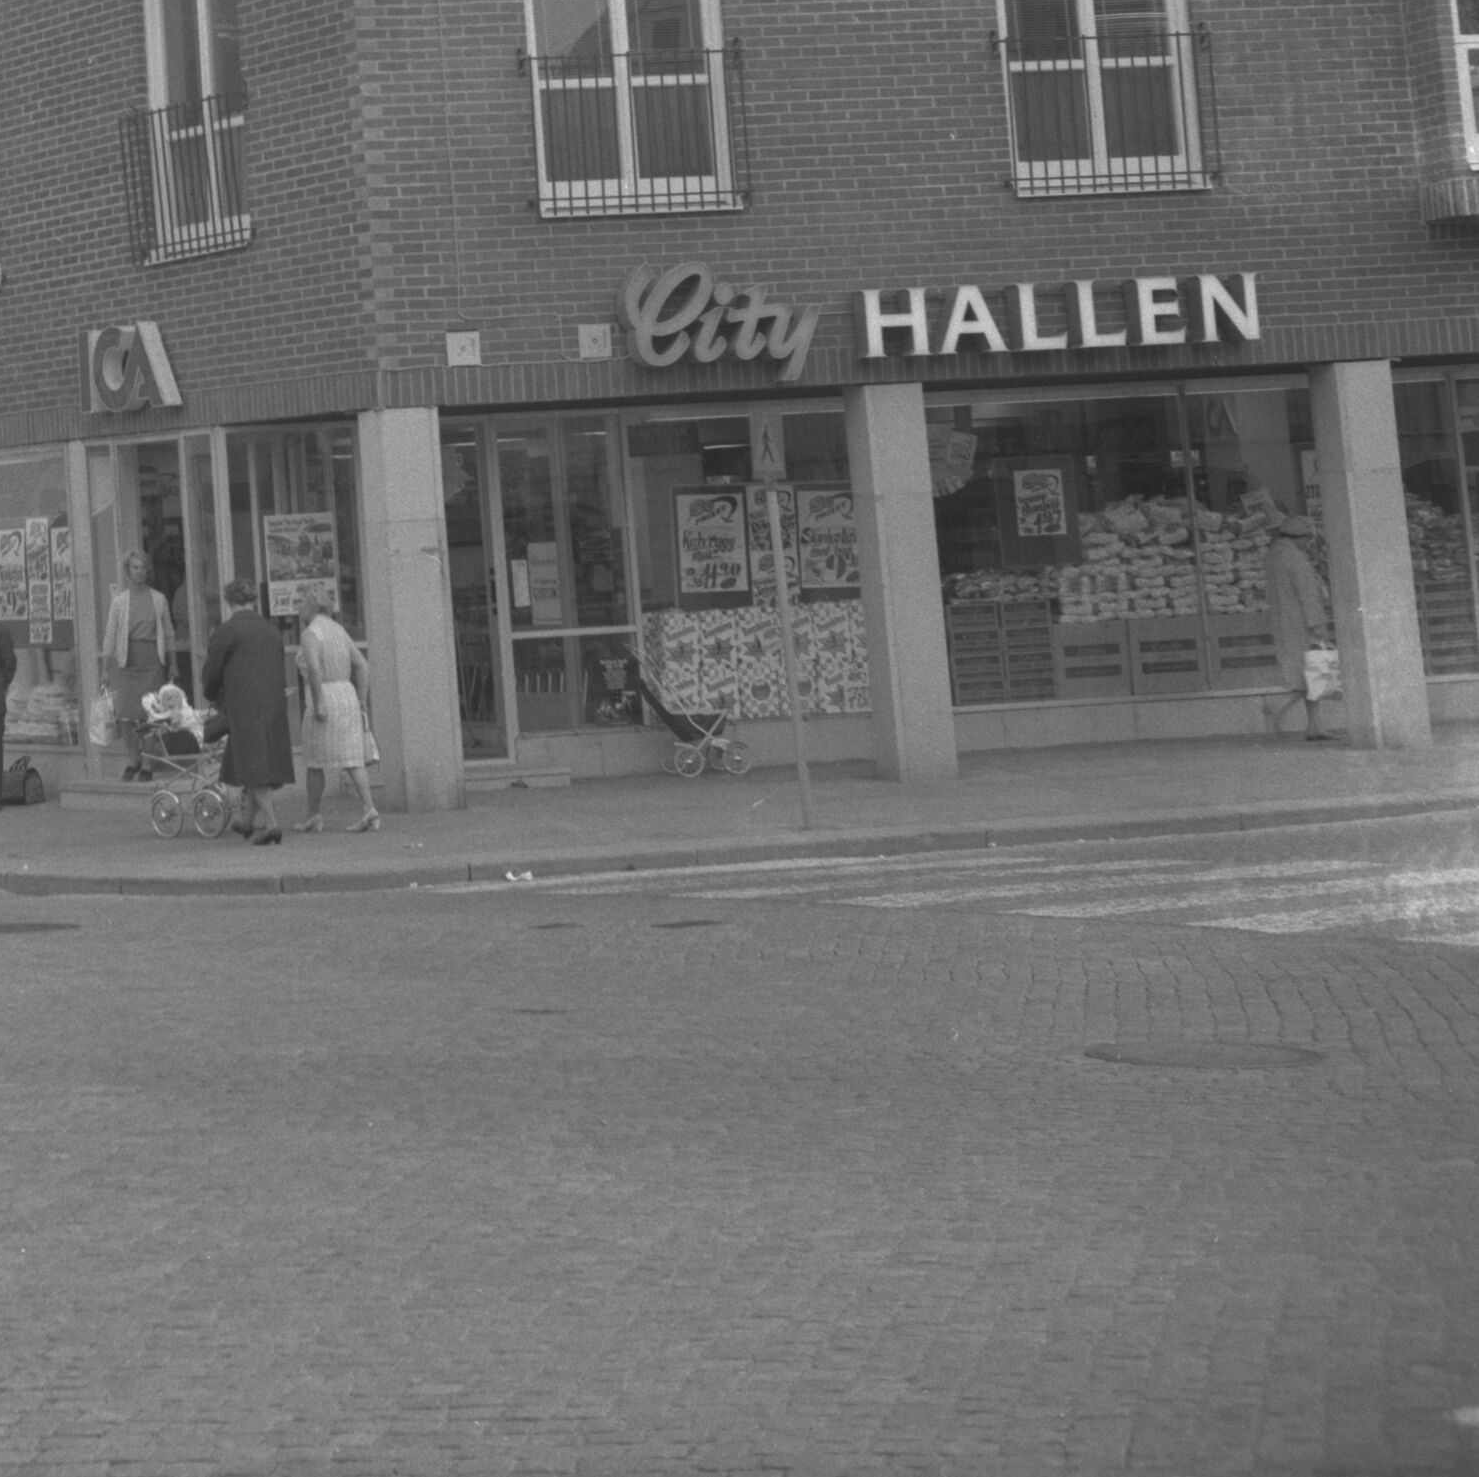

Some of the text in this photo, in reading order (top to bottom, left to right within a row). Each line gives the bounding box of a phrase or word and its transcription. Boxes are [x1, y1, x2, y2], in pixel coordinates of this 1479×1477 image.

[78, 321, 183, 414] ICA
[621, 258, 1260, 382] City HALLEN
